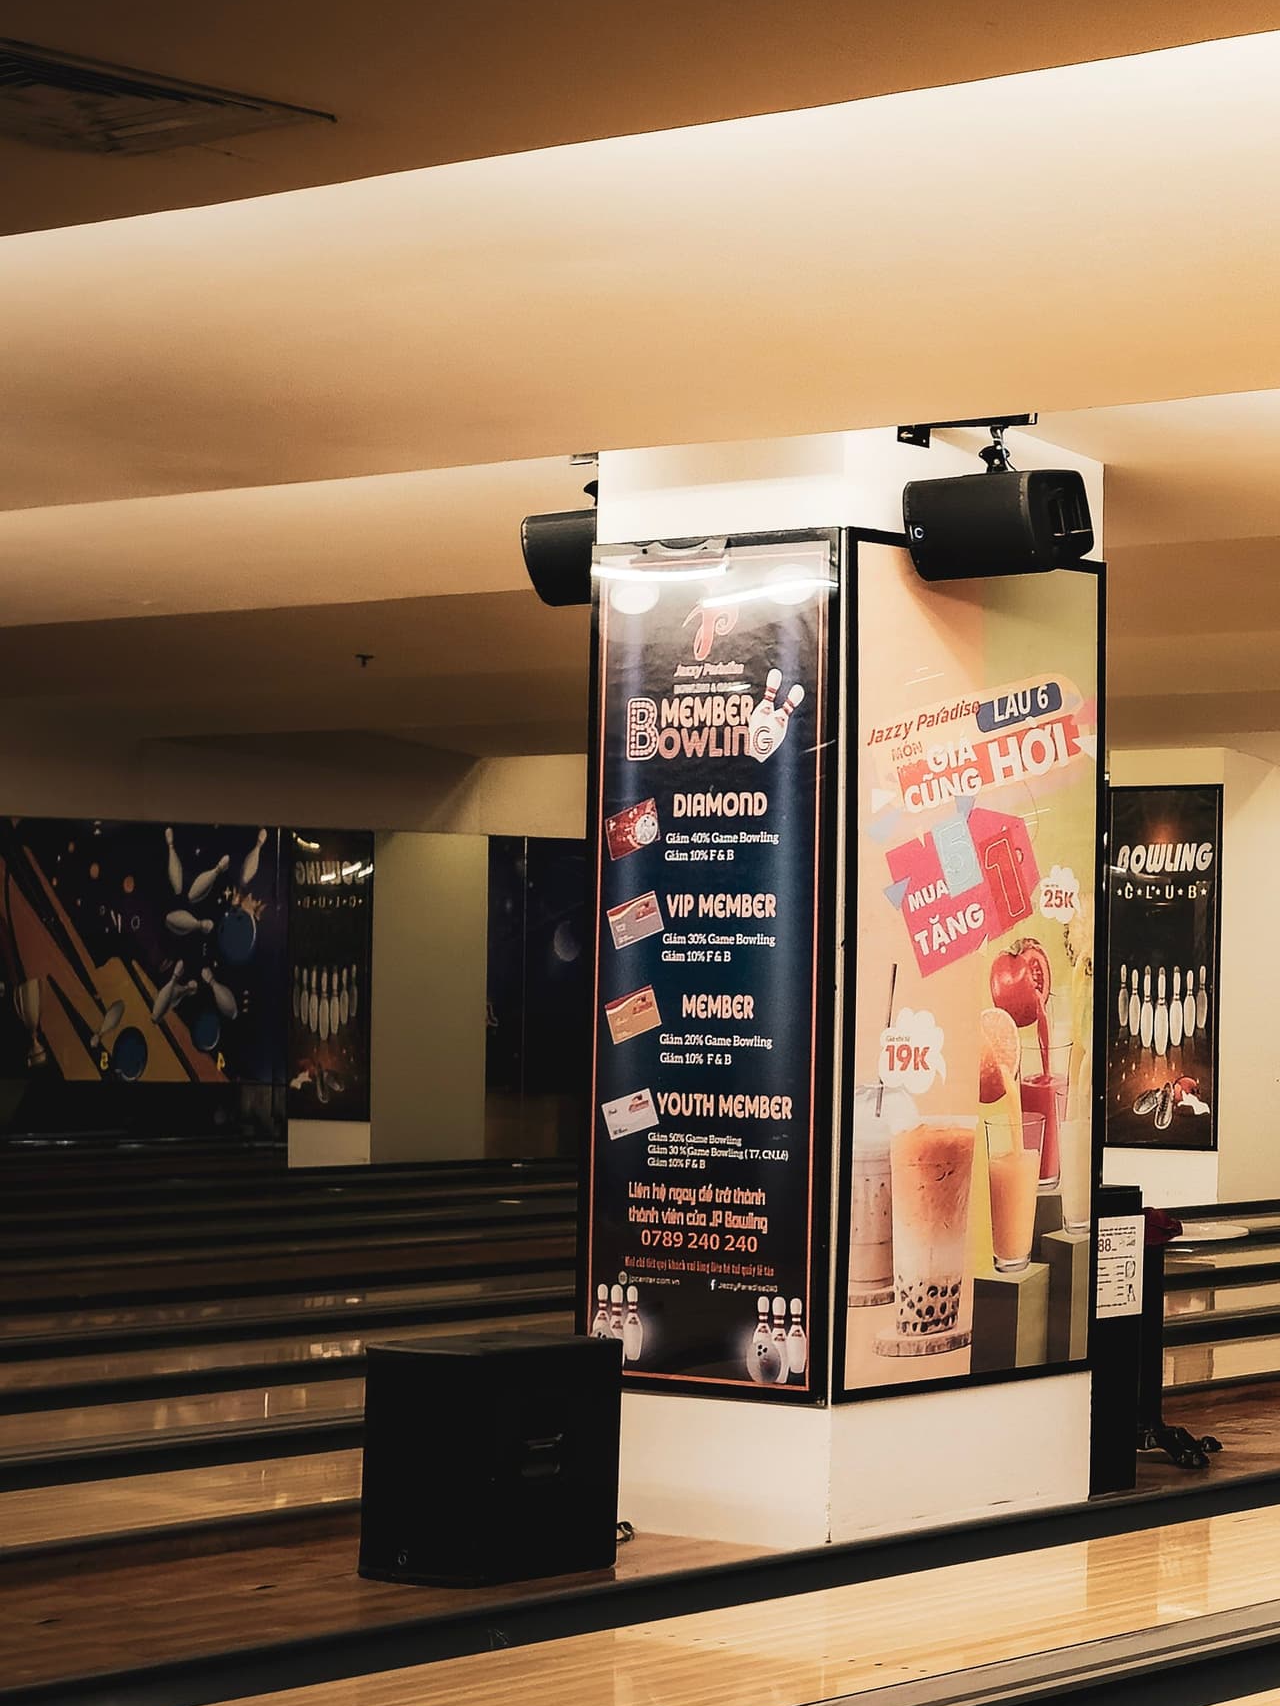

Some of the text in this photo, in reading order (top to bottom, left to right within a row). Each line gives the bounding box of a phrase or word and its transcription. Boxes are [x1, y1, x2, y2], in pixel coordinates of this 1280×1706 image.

[660, 695, 754, 729] MEMBER
[866, 720, 914, 747] Jazzy
[1037, 684, 1049, 709] 6
[626, 696, 775, 761] BOWLING
[904, 766, 983, 814] CŨNG
[672, 791, 768, 818] DIAMOND
[711, 832, 739, 844] Game
[739, 831, 780, 847] Bowling
[1116, 842, 1214, 873] BOWLING
[666, 893, 694, 918] VIP
[698, 893, 777, 919] MEMBER
[907, 879, 950, 913] MUA
[1043, 888, 1074, 909] 25K
[707, 933, 735, 945] Game
[736, 932, 776, 948] Bowling
[914, 902, 985, 956] TẶNG
[682, 994, 754, 1020] MEMBER
[704, 1034, 732, 1047] Game
[732, 1035, 773, 1050] Bowling
[885, 1044, 930, 1071] 19K
[656, 1092, 714, 1117] YOUTH
[718, 1093, 793, 1121] MEMBER
[685, 1134, 708, 1145] Game
[708, 1135, 742, 1147] Bowling
[687, 1147, 710, 1157] Game
[710, 1147, 744, 1161] Bowling
[709, 1210, 723, 1227] JP
[724, 1211, 768, 1234] Bowling
[641, 1229, 758, 1253] 0789 240 240
